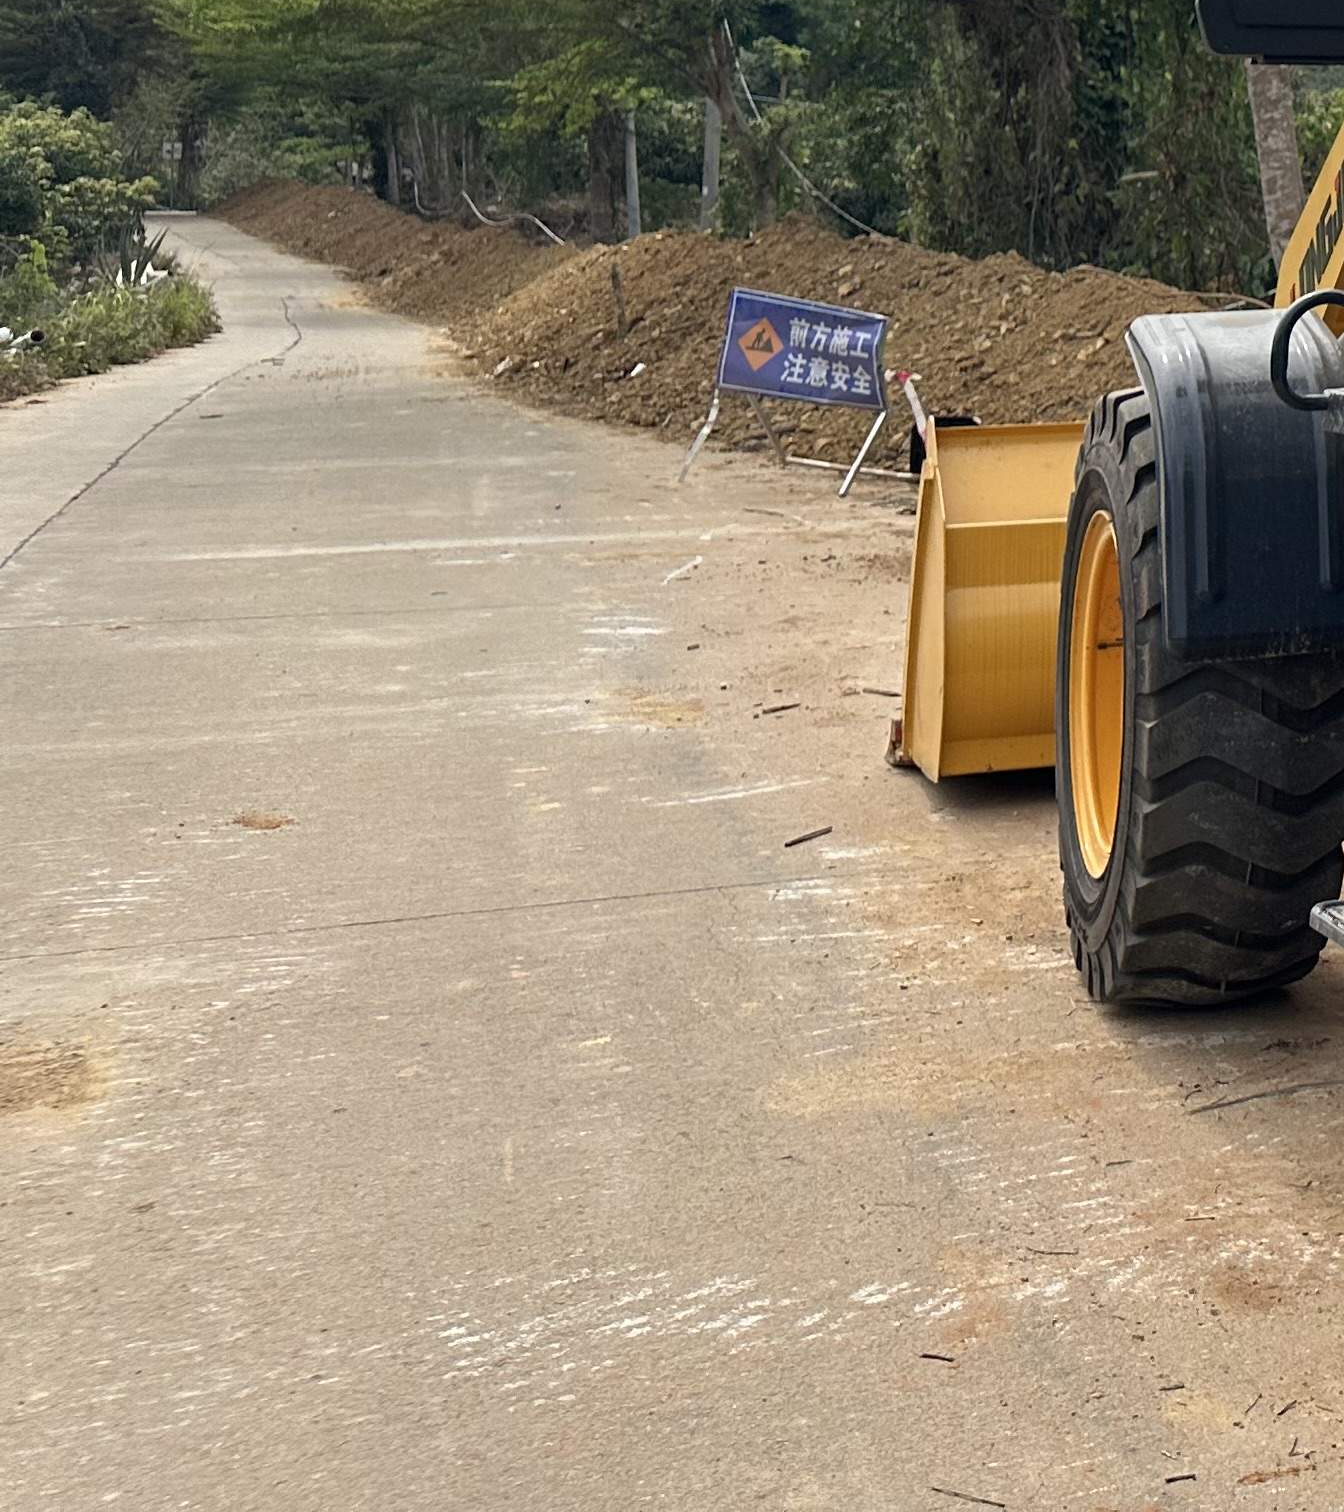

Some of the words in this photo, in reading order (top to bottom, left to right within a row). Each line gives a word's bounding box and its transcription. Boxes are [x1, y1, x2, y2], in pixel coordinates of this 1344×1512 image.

[789, 316, 872, 358] 前方施工
[780, 352, 872, 396] 注意安全
